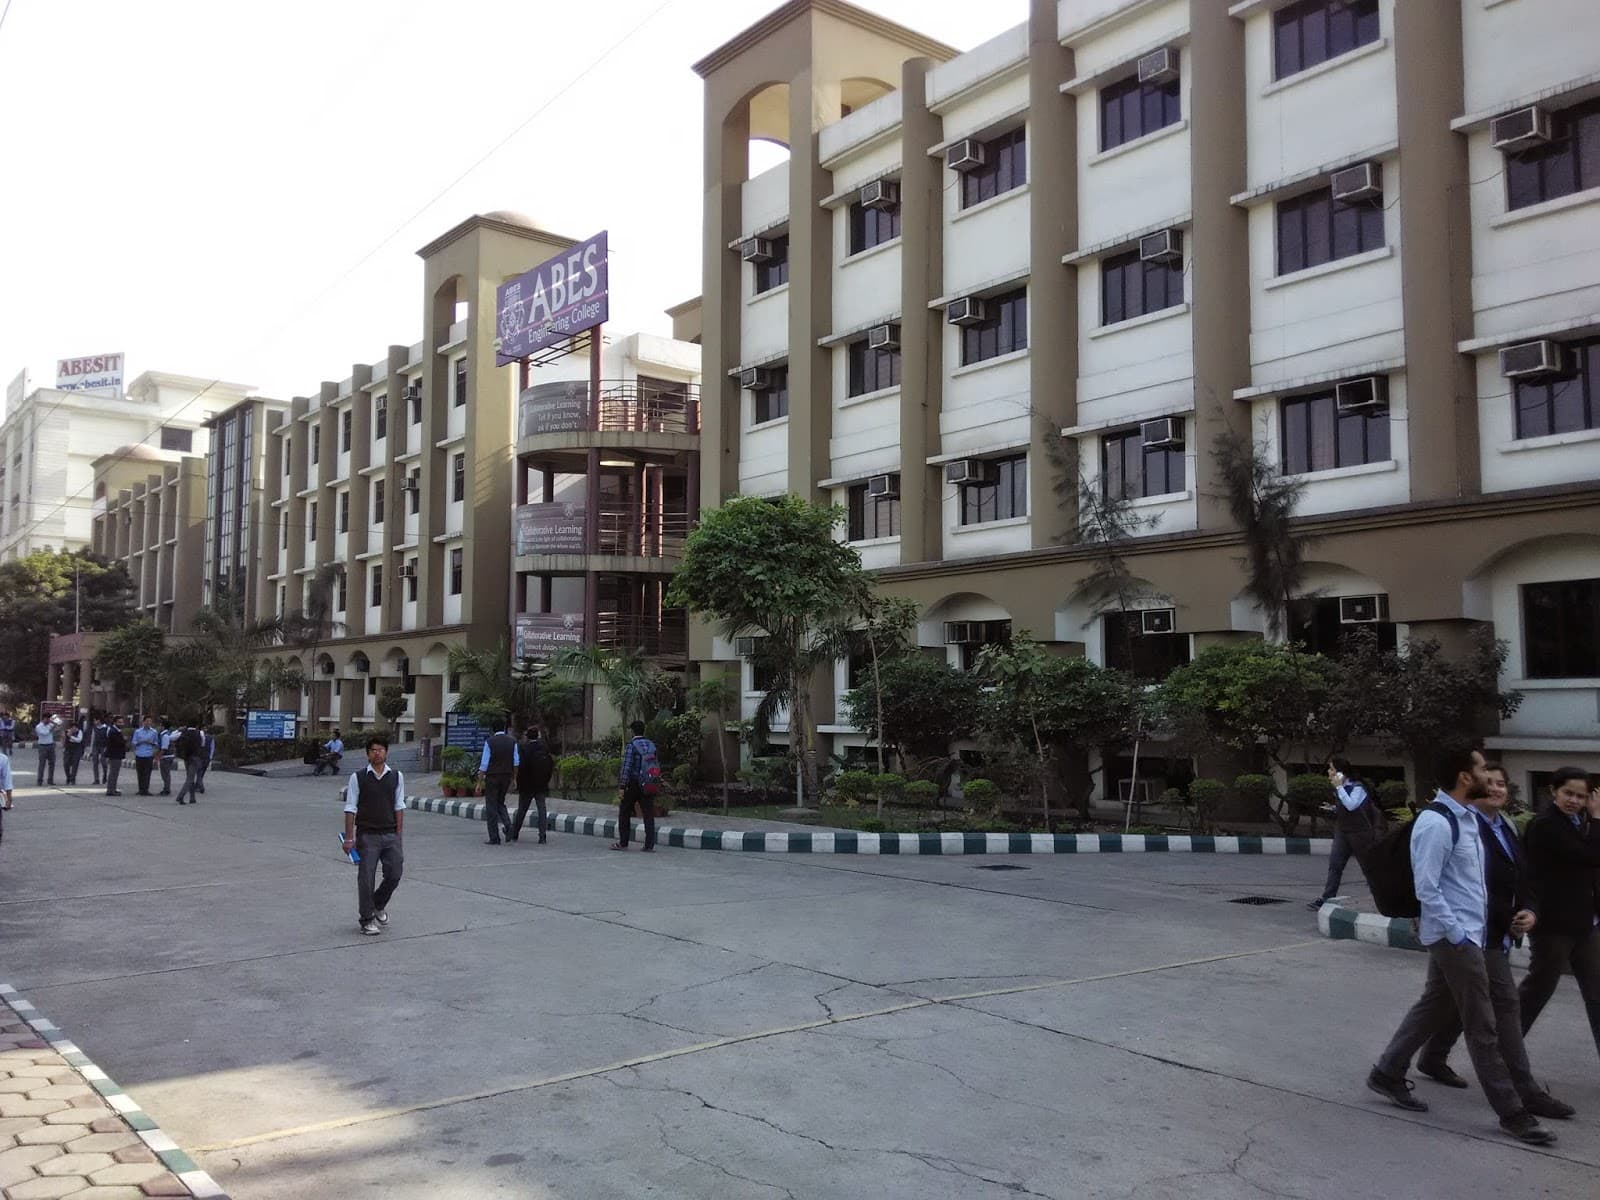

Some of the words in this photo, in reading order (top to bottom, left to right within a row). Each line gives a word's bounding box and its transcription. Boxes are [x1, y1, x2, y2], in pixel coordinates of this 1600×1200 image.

[528, 243, 598, 324] ABES
[571, 301, 600, 324] College
[58, 355, 120, 377] ABESIT
[555, 524, 583, 535] Learning
[553, 631, 581, 643] Learning
